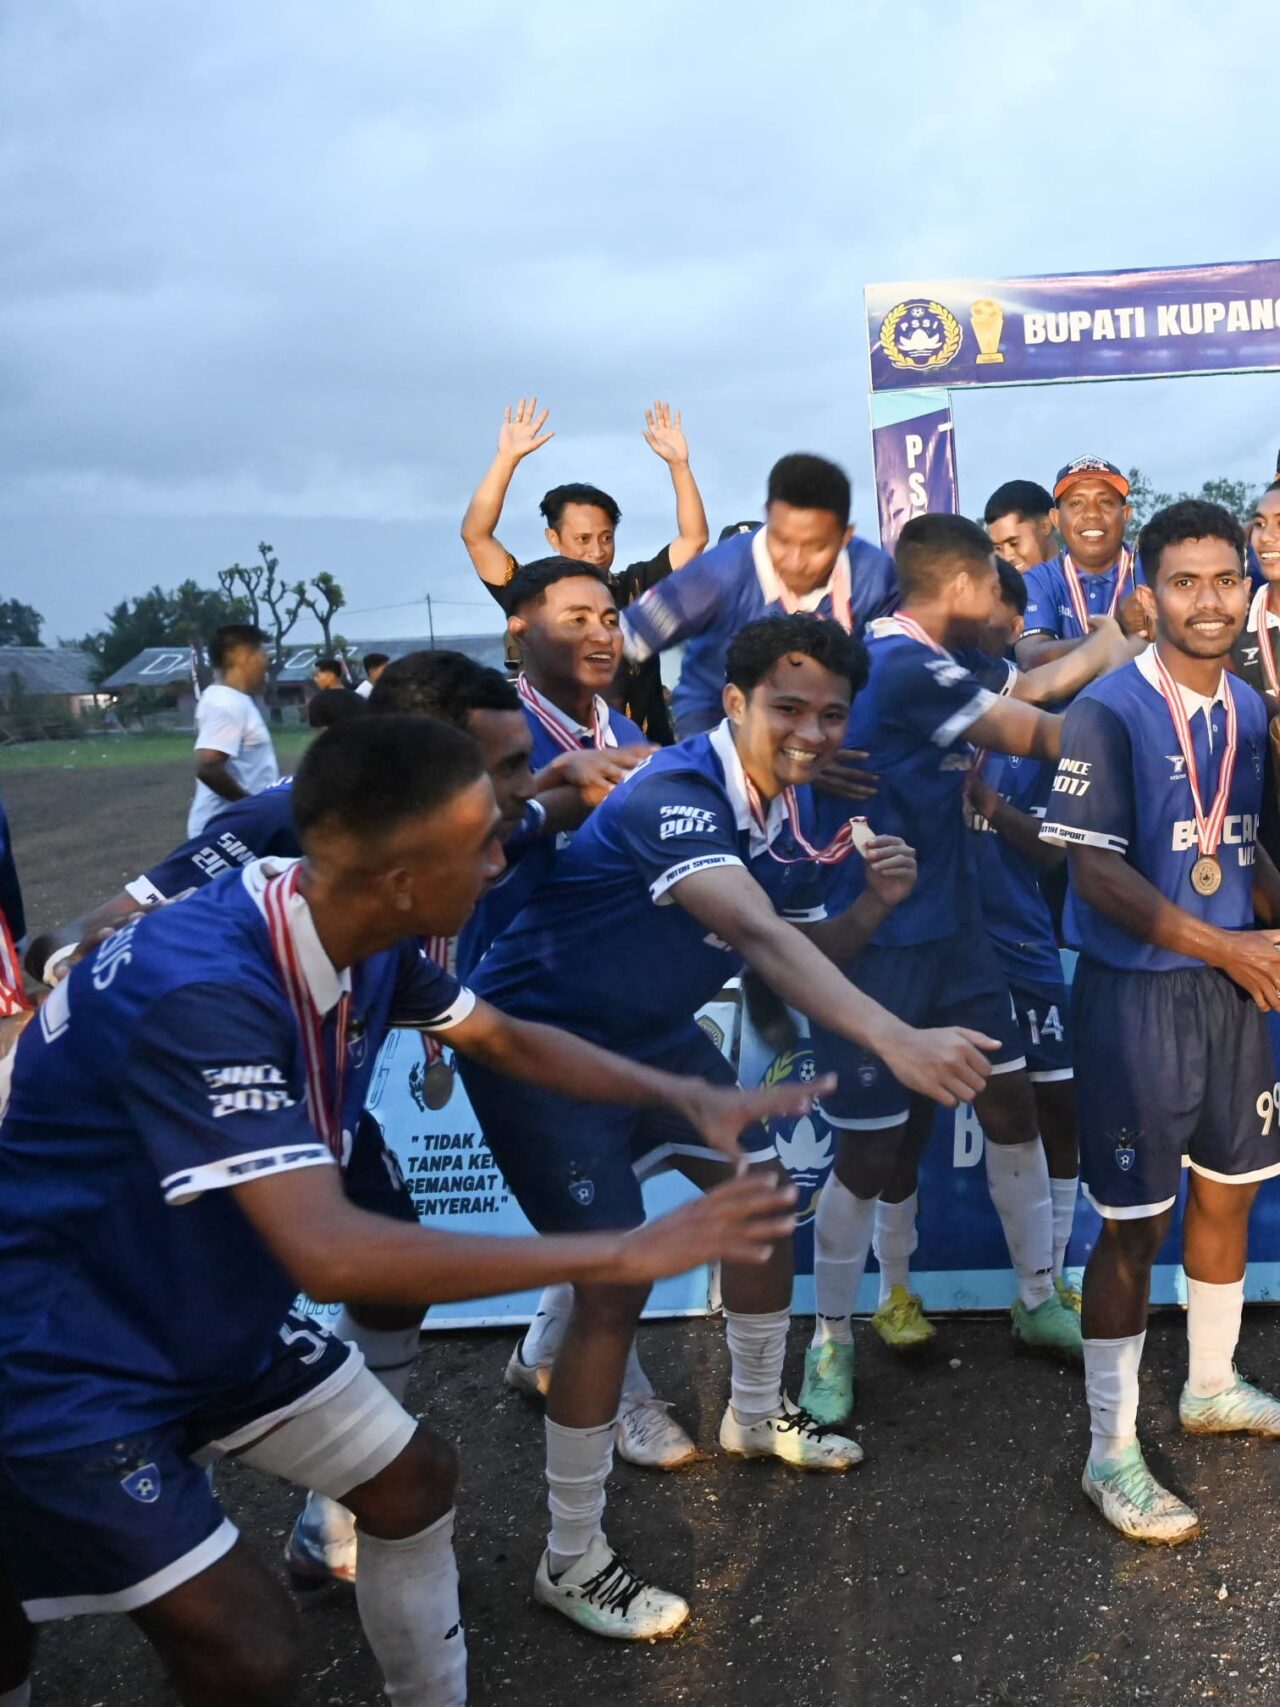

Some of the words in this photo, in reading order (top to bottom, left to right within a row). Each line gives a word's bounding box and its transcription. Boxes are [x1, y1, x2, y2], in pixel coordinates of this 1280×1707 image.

[900, 319, 938, 331] PSSI
[1024, 306, 1146, 345] BUPATI
[1058, 758, 1092, 776] INCE
[660, 805, 717, 823] SINCE
[1059, 829, 1086, 840] SPORT
[693, 857, 726, 869] SPORT
[1026, 1005, 1065, 1045] 14
[423, 1133, 475, 1151] TIDAK
[407, 1154, 463, 1173] TANPA
[404, 1175, 499, 1195] SEMANGAT
[413, 1195, 509, 1217] ENYERAH."
